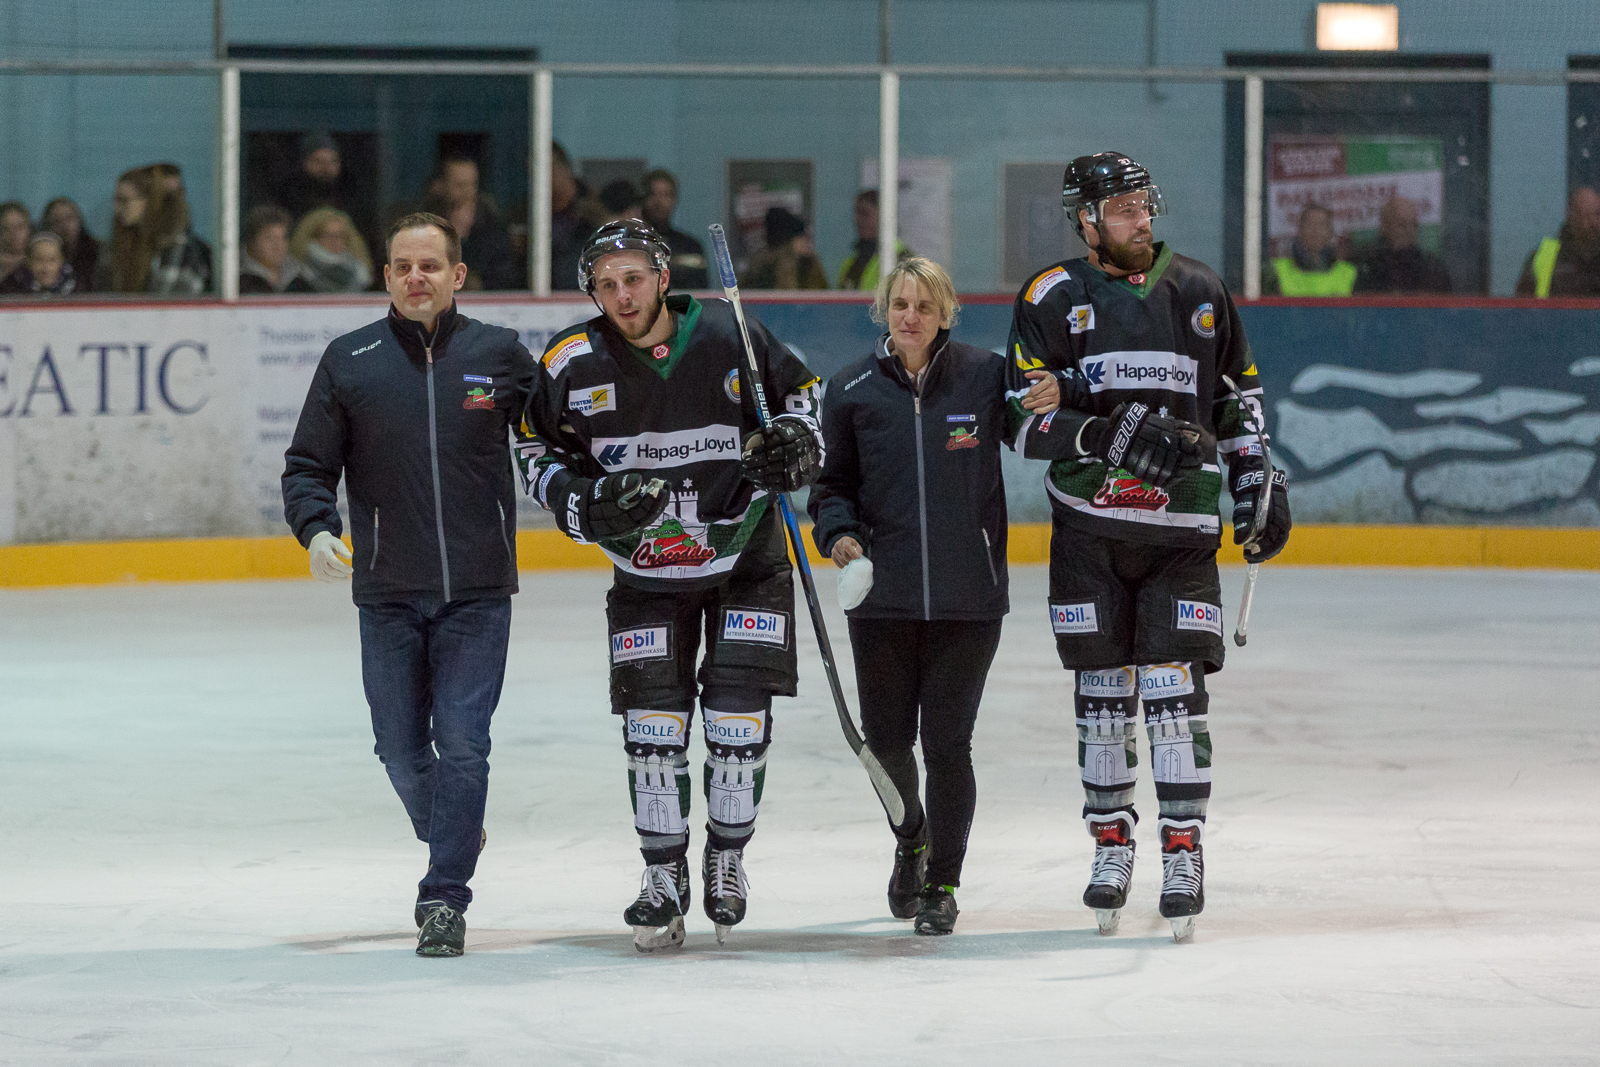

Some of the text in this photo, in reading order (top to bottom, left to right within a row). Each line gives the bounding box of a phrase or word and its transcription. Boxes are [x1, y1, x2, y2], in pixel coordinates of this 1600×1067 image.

[594, 233, 624, 244] BAUER
[352, 340, 381, 355] BAUER
[845, 370, 871, 390] BAUER
[755, 383, 772, 428] BAUER
[637, 437, 736, 461] Hapag-Lloyd
[1089, 482, 1169, 511] Crocodiles
[631, 542, 715, 570] Crocodiles
[727, 613, 777, 632] Mobil
[1051, 606, 1086, 623] Mobil
[1179, 603, 1219, 624] Mobil
[613, 631, 655, 652] Mobil
[1082, 672, 1124, 687] STOLLE
[1139, 674, 1179, 691] STOLLE
[630, 719, 675, 737] STOLLE
[707, 719, 752, 738] STOLLE
